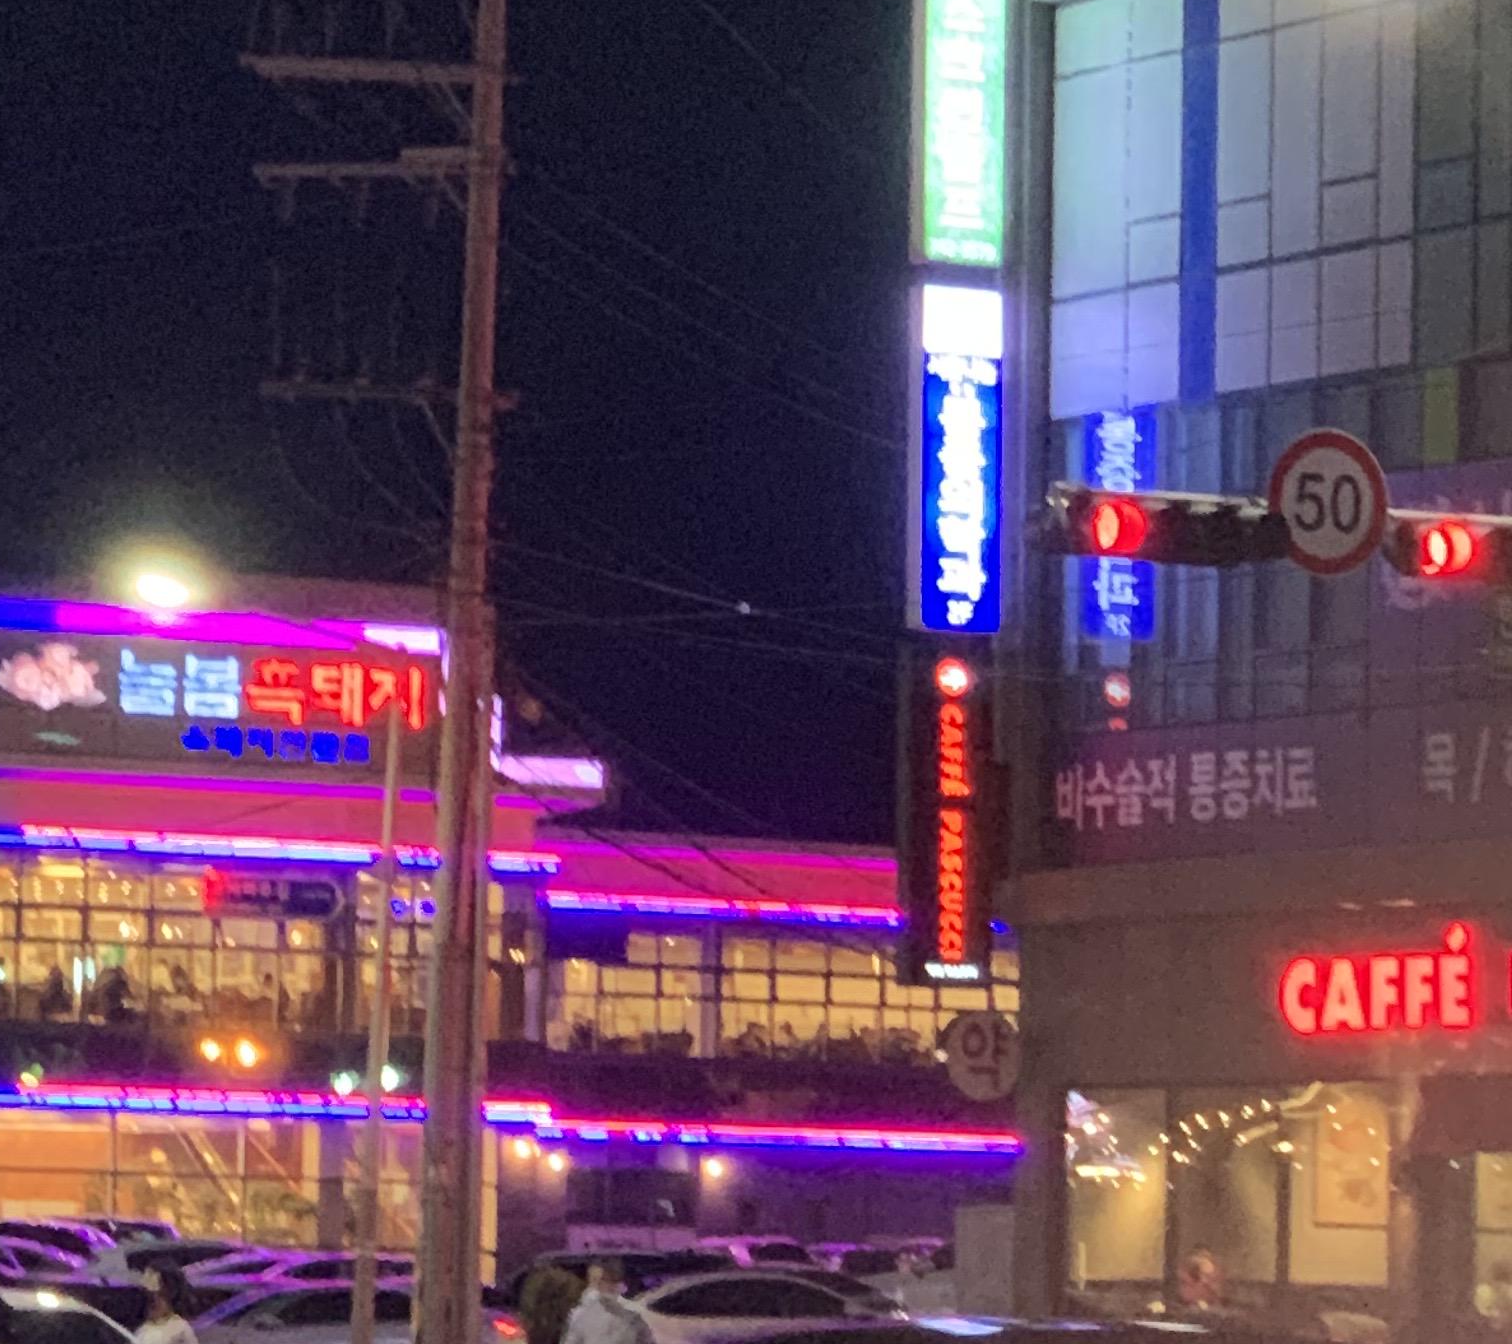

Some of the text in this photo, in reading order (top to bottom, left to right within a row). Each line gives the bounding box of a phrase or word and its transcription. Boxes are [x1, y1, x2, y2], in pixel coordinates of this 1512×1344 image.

[1294, 472, 1362, 535] 50
[1056, 747, 1318, 831] 비수술적 통증치료
